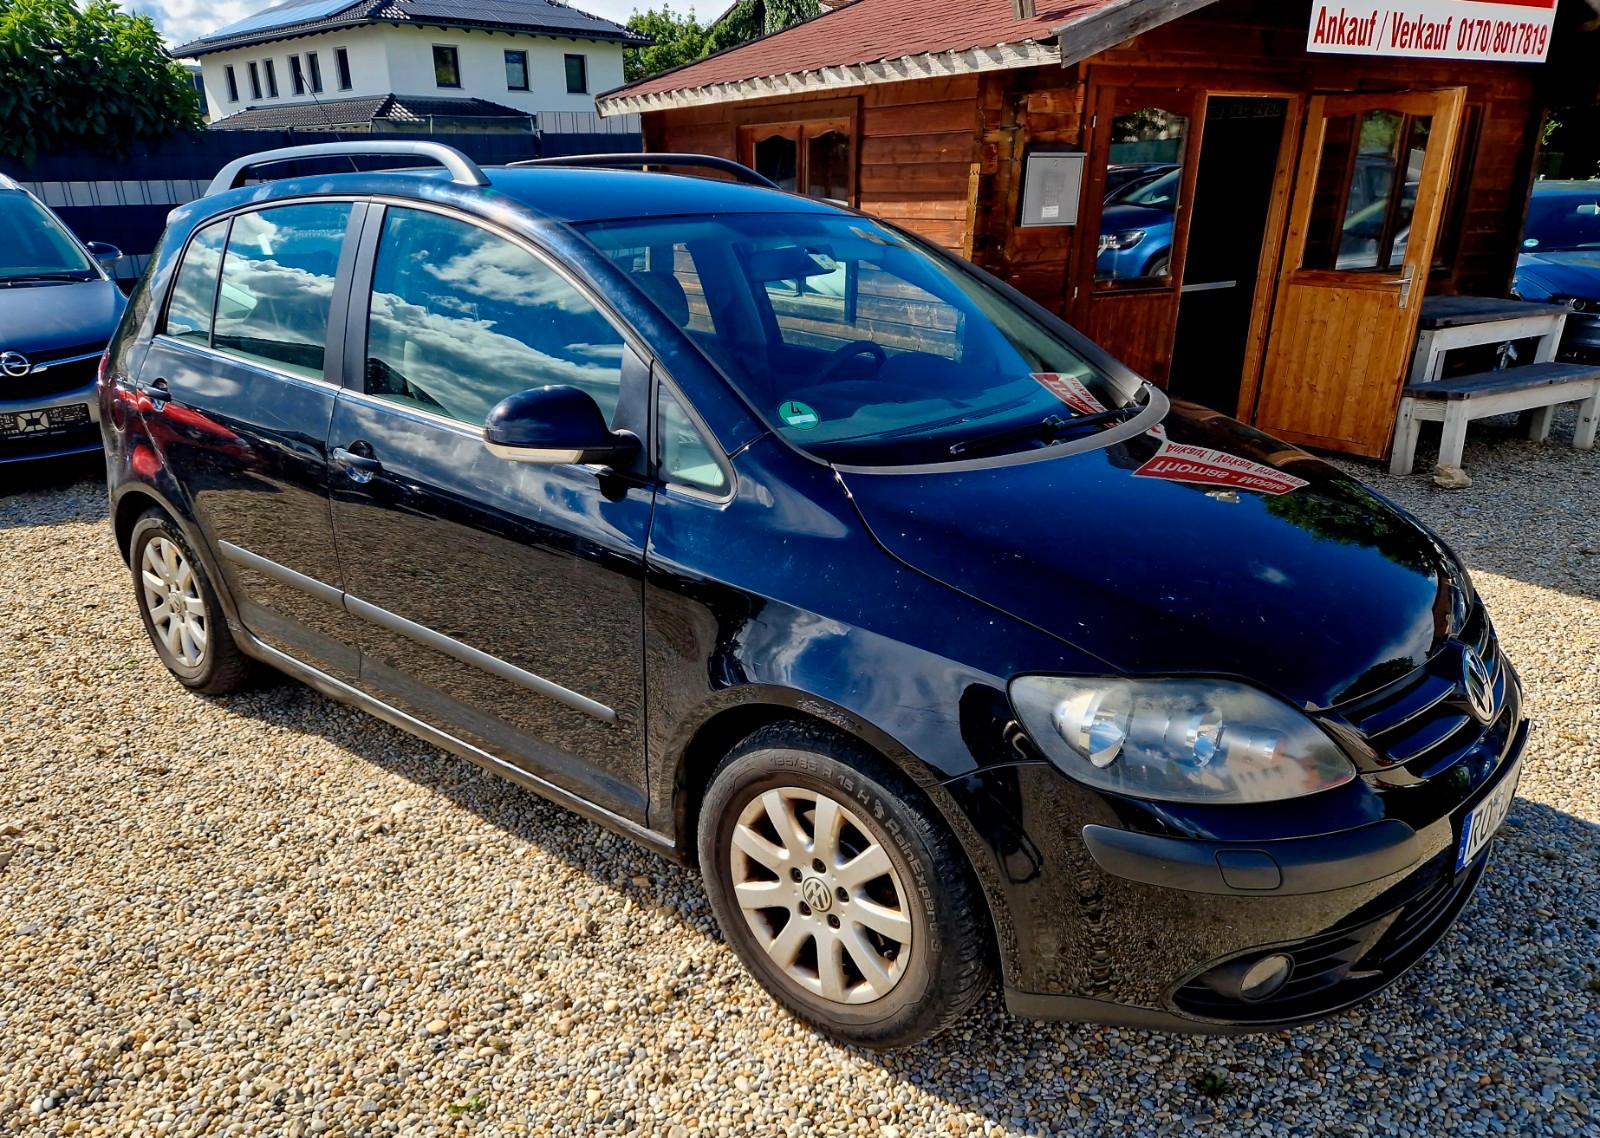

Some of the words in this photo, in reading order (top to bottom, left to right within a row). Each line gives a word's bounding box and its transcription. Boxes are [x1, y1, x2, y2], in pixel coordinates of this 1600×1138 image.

[1313, 6, 1378, 47] Ankauf
[1390, 12, 1453, 51] Verkauf
[1456, 17, 1548, 56] 0170/8017819
